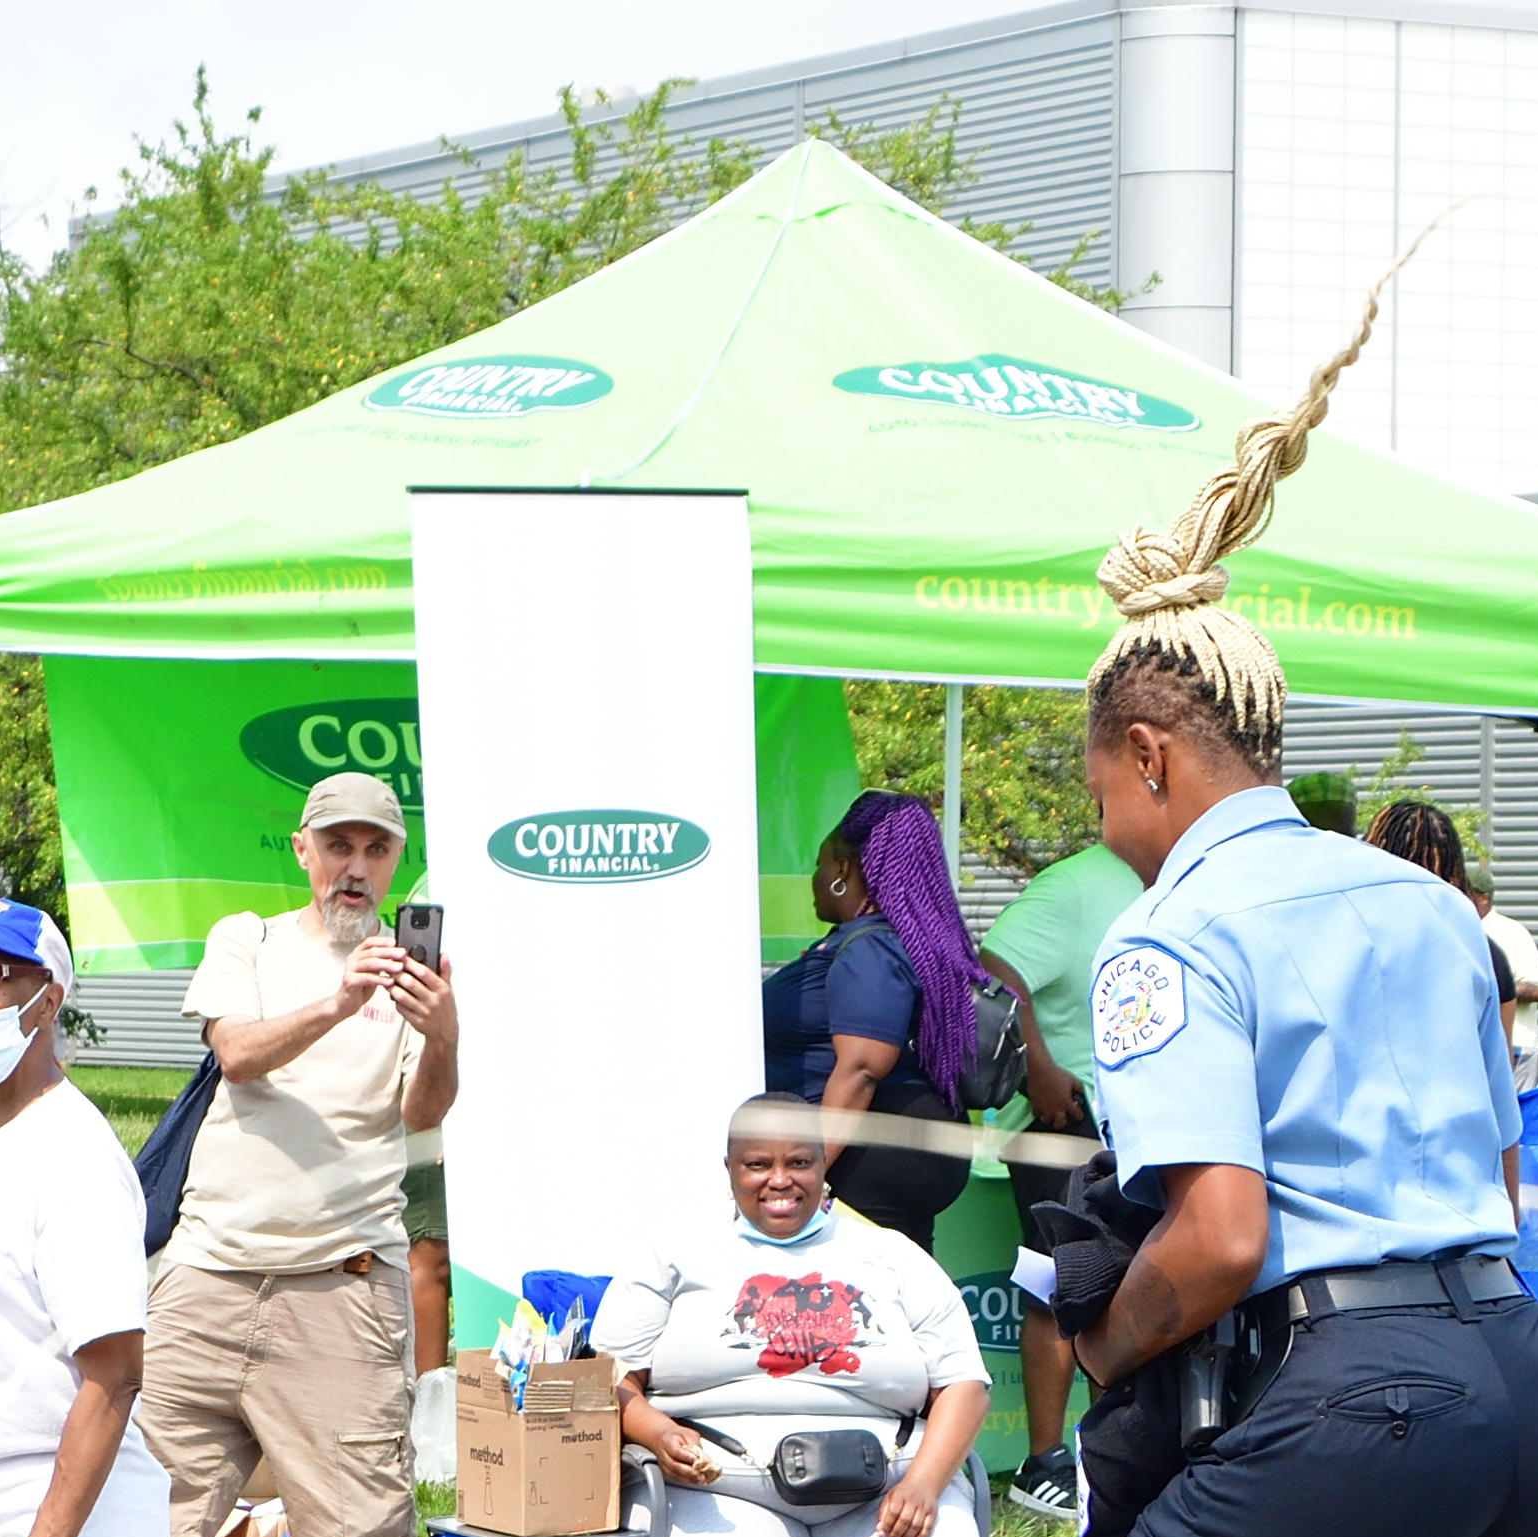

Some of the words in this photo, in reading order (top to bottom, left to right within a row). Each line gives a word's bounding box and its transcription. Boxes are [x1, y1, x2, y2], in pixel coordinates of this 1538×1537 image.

[398, 365, 595, 397] COUNTRY
[878, 365, 1146, 417] COUNTRY
[915, 572, 1417, 639] countrycial.com
[515, 822, 681, 858] COUNTRY
[547, 856, 654, 874] FINANCIAL
[1098, 958, 1170, 1013] CHICAGO
[361, 1004, 397, 1024] UNTEER
[1102, 1010, 1167, 1053] POLICE
